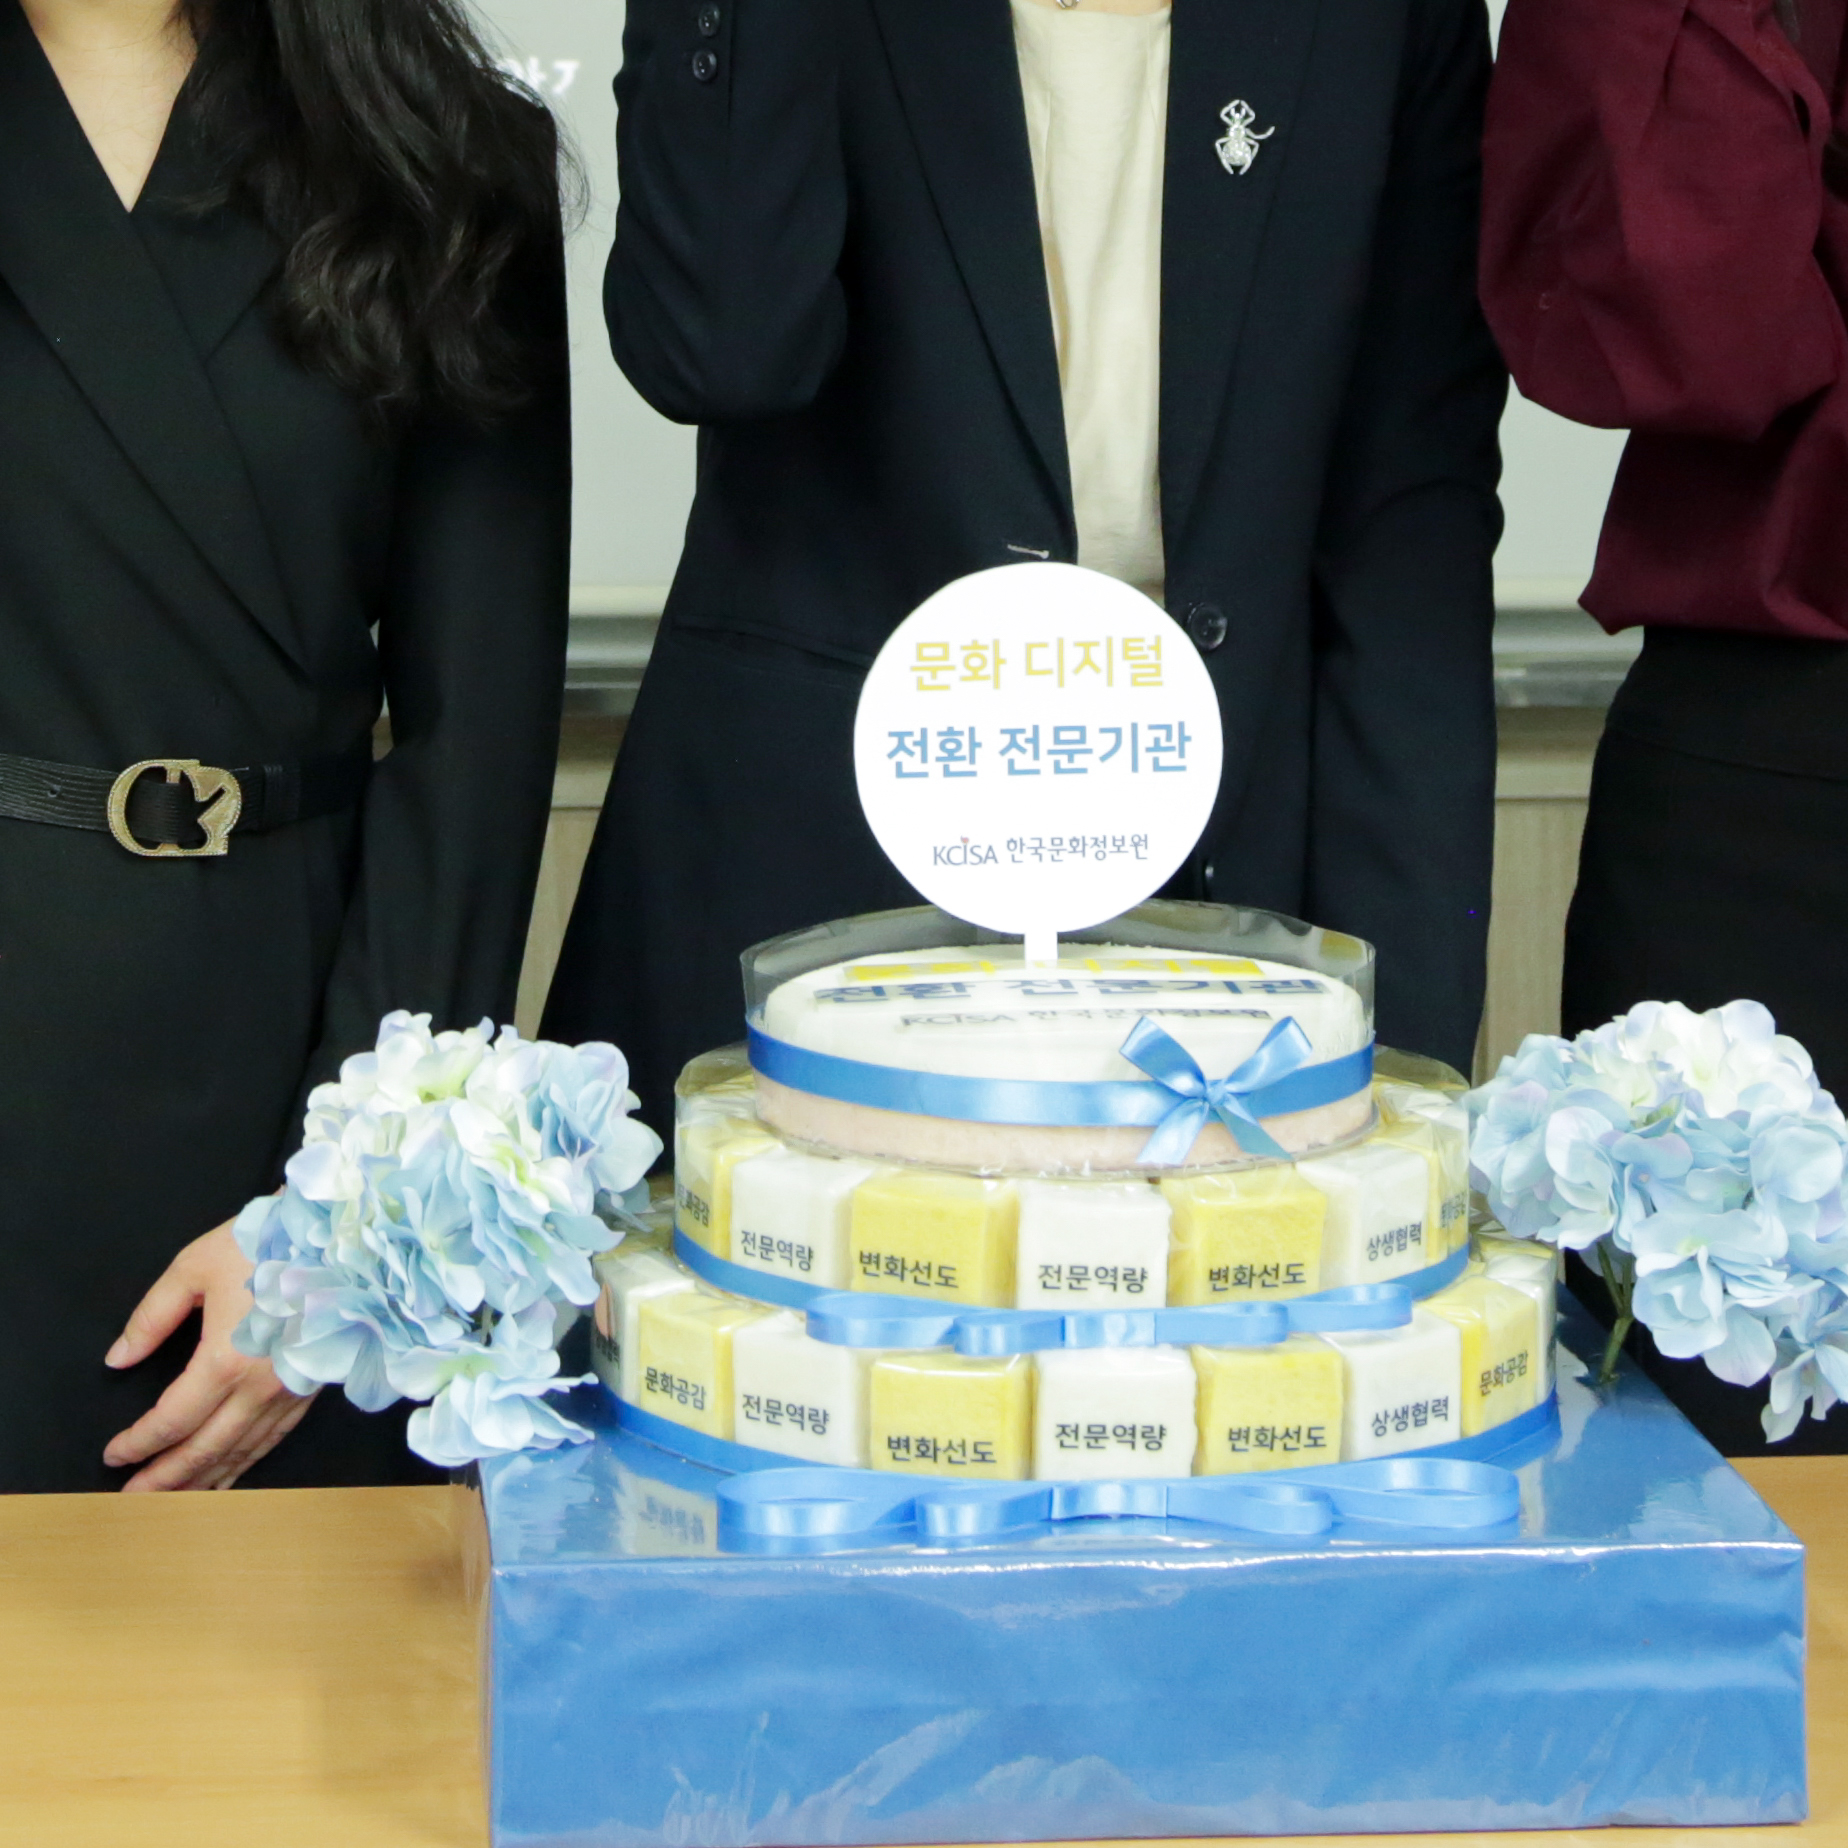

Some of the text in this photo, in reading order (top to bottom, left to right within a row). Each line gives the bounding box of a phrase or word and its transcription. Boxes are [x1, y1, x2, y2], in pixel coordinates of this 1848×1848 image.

[910, 634, 1164, 691] 문화 디지털
[886, 720, 1192, 779] 전환 전문기관
[932, 833, 1150, 866] KCISA 한국문화정보원
[740, 1230, 815, 1273] 전문역량
[1366, 1221, 1423, 1262] 상생협력
[859, 1250, 959, 1289] 변화선도
[1037, 1263, 1149, 1294] 전문역량
[1208, 1261, 1307, 1293] 변화선도
[644, 1366, 708, 1411] 문화공감
[1479, 1350, 1529, 1397] 문화공감
[742, 1394, 830, 1436] 전문역량
[1371, 1395, 1450, 1438] 상생협력
[887, 1435, 998, 1465] 변화선도
[1054, 1422, 1168, 1452] 전문역량
[1227, 1424, 1327, 1453] 변화선도
